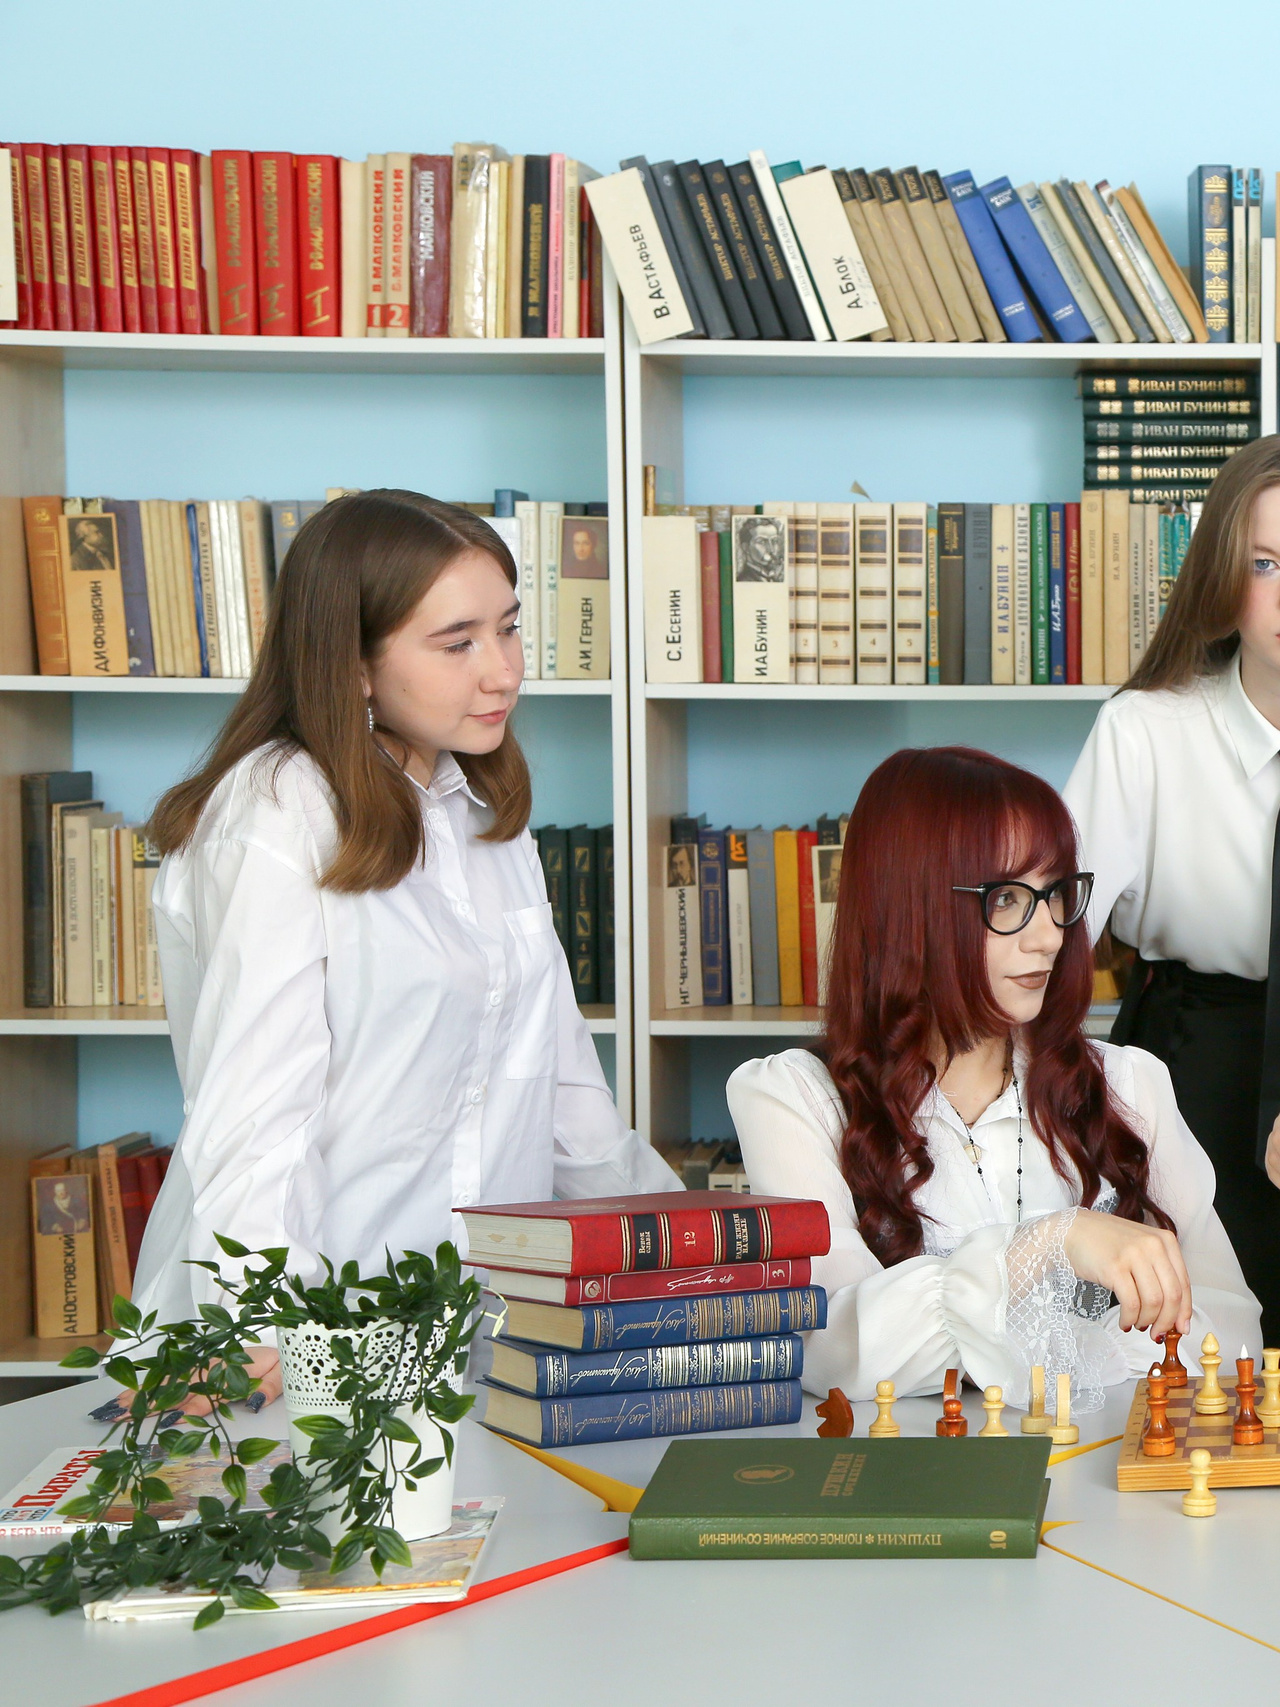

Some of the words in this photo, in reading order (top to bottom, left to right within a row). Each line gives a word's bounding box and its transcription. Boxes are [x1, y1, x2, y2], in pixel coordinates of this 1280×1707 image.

[373, 305, 381, 326] 1
[389, 305, 402, 326] 2
[1141, 380, 1175, 391] ИВАН
[1178, 380, 1222, 391] БУНИН
[1145, 401, 1181, 413] ИВАН
[1183, 401, 1227, 413] БУНИН
[1144, 424, 1179, 436] ИВАН
[1182, 424, 1225, 436] БУНИН
[1143, 446, 1178, 457] ИВАН
[1180, 446, 1223, 456] БУНИН
[1143, 467, 1178, 479] ИВАН
[1183, 489, 1209, 500] БУН
[684, 1231, 696, 1247] 12
[772, 1268, 786, 1278] 3
[11, 1527, 36, 1536] ЕСТЬ
[40, 1526, 62, 1535] ЧТО
[698, 1533, 762, 1547] СОЧИНЕНИЙ
[764, 1533, 818, 1545] СОБРАНИЕ
[820, 1533, 862, 1545] ПОЛНОЕ
[878, 1533, 942, 1546] ПУШКИН
[990, 1530, 1007, 1548] 10
